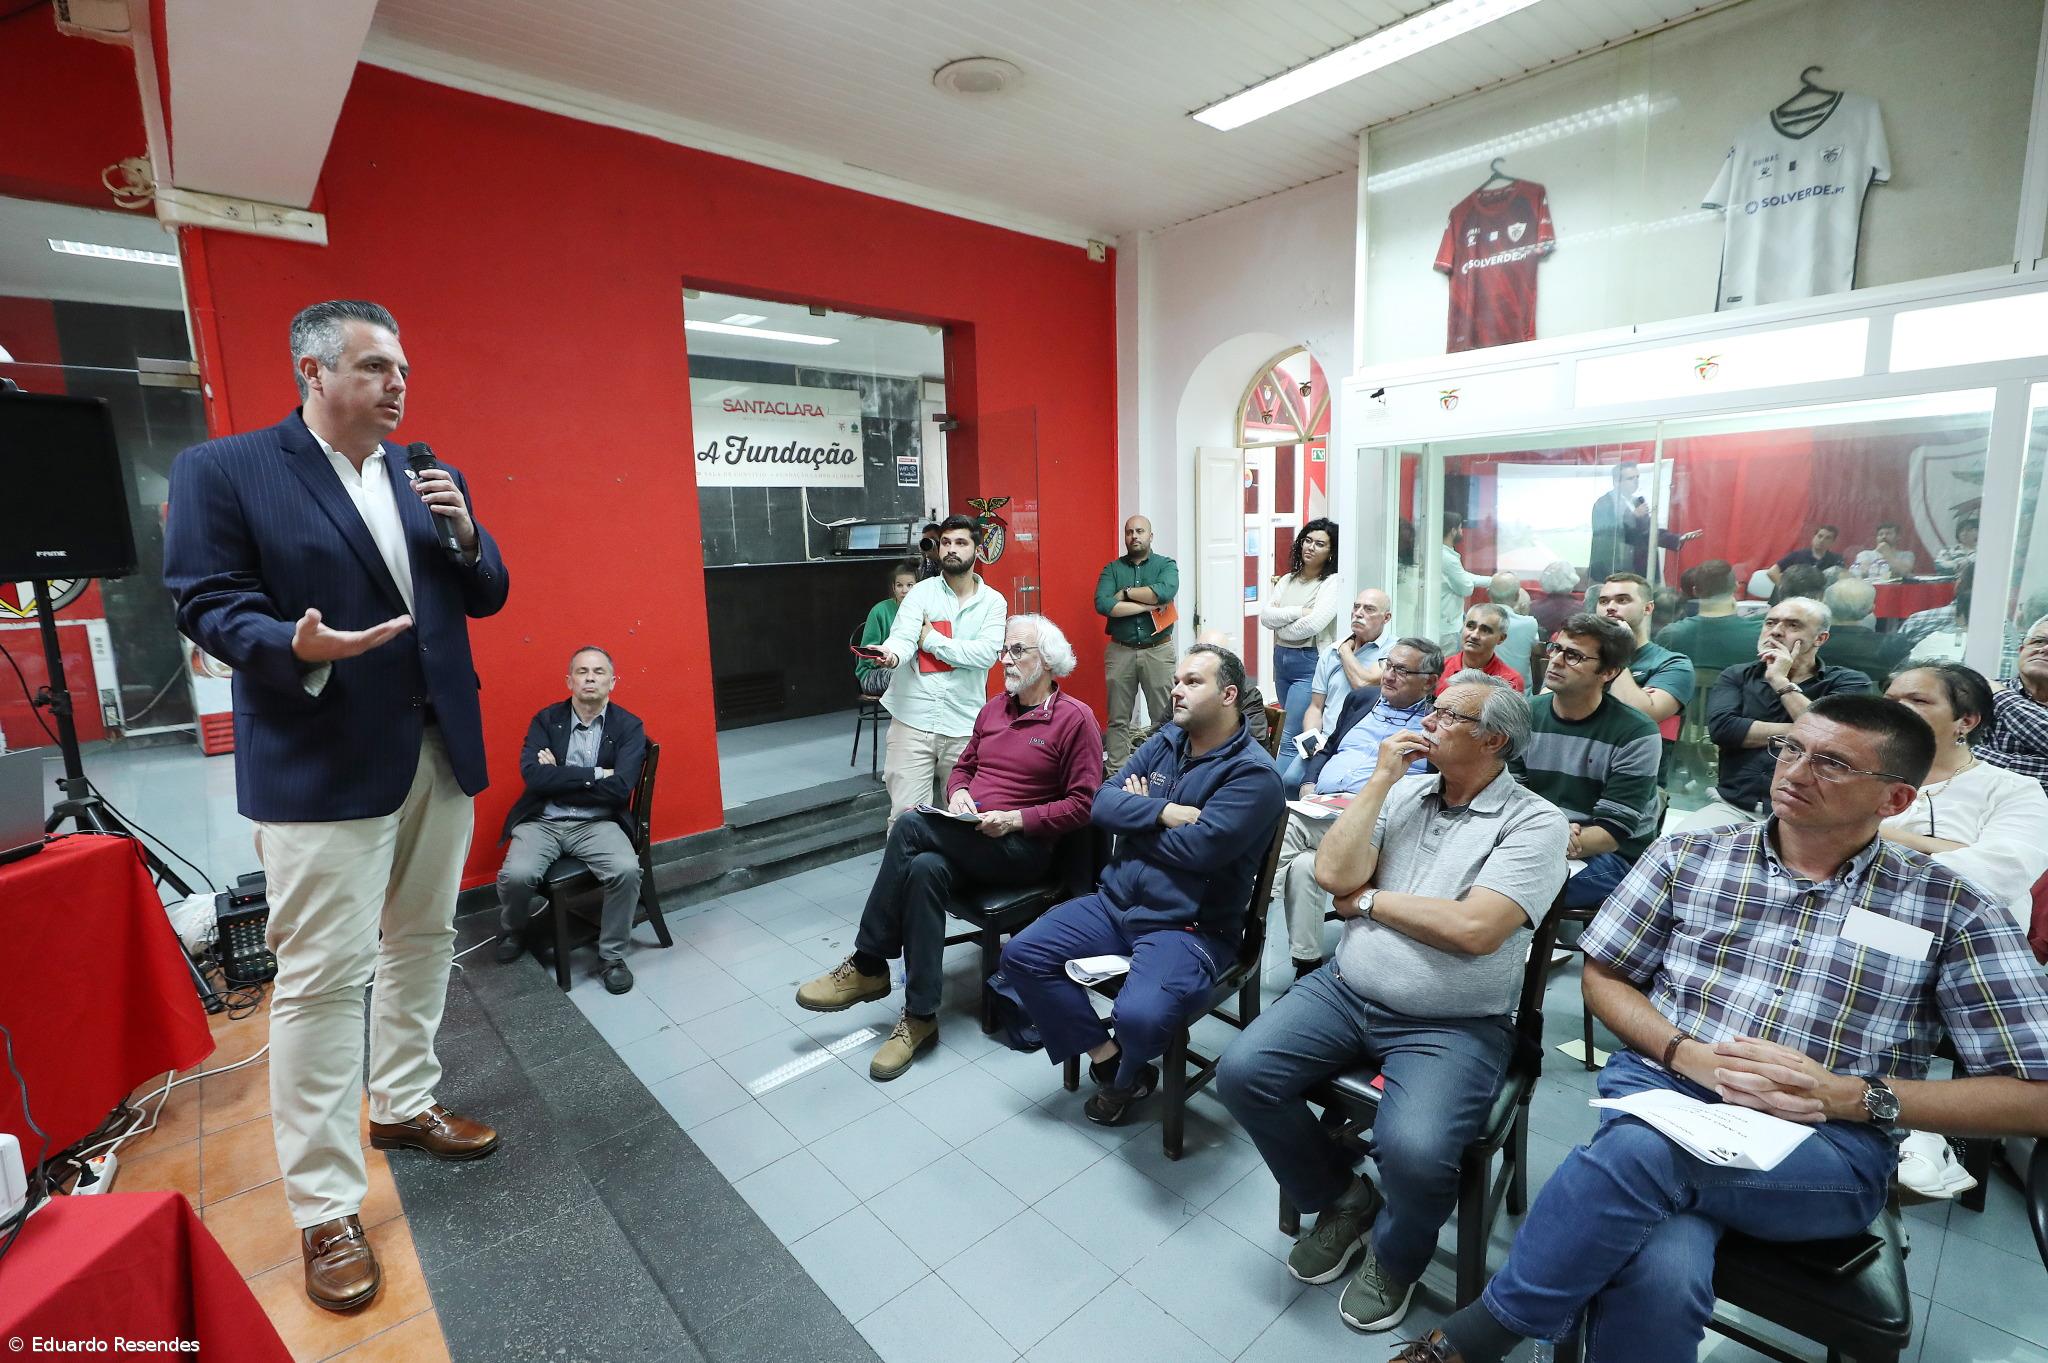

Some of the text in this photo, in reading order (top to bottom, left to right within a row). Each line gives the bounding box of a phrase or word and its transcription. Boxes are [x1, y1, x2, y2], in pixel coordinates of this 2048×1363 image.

[1761, 184, 1846, 208] SOLVERDE.PT
[722, 399, 825, 418] SANTACLARA
[697, 435, 858, 470] A Fundação
